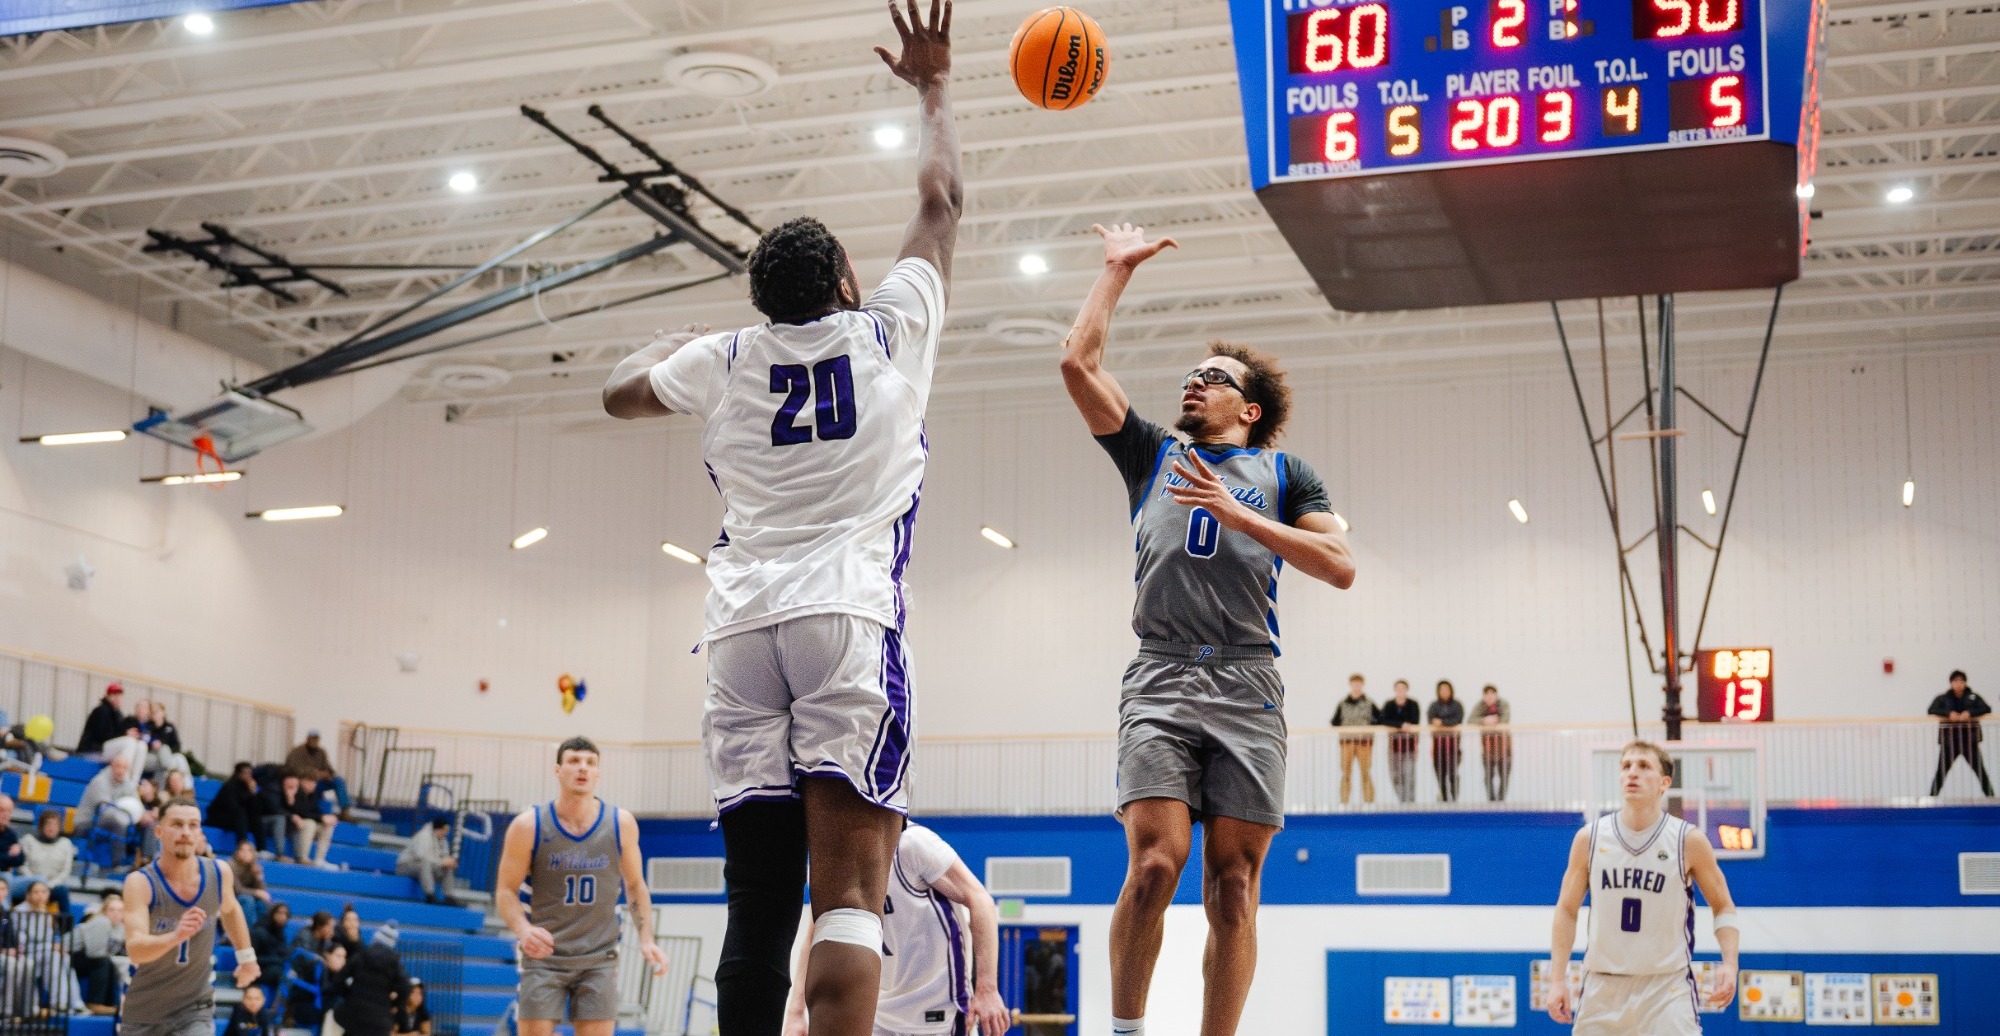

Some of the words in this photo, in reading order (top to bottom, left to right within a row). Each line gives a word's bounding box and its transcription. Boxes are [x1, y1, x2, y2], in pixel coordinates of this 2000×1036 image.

[1451, 5, 1468, 27] P
[1493, 0, 1525, 48] 2
[1549, 19, 1567, 41] B
[1305, 3, 1387, 73] 60
[1452, 29, 1470, 50] B
[1051, 35, 1081, 100] Wilson
[1594, 57, 1648, 84] T.O.L.
[1668, 44, 1745, 77] FOULS
[1287, 82, 1359, 114] FOULS
[1377, 78, 1429, 105] T.O.L.
[1446, 68, 1520, 98] PLAYER
[1528, 64, 1581, 91] FOUL
[1543, 91, 1572, 142] 3
[1606, 87, 1639, 132] 4
[1710, 75, 1741, 127] 5
[1325, 111, 1357, 162] 6
[1389, 105, 1420, 156] 5
[1451, 96, 1520, 150] 20
[1668, 128, 1706, 143] SETS
[1709, 125, 1747, 140] WON
[770, 354, 857, 447] 20
[1185, 505, 1221, 560] 0
[1195, 645, 1214, 663] P
[1725, 679, 1762, 721] 13
[564, 874, 596, 906] 10
[1602, 867, 1666, 894] ALFRED
[1620, 897, 1642, 933] 0
